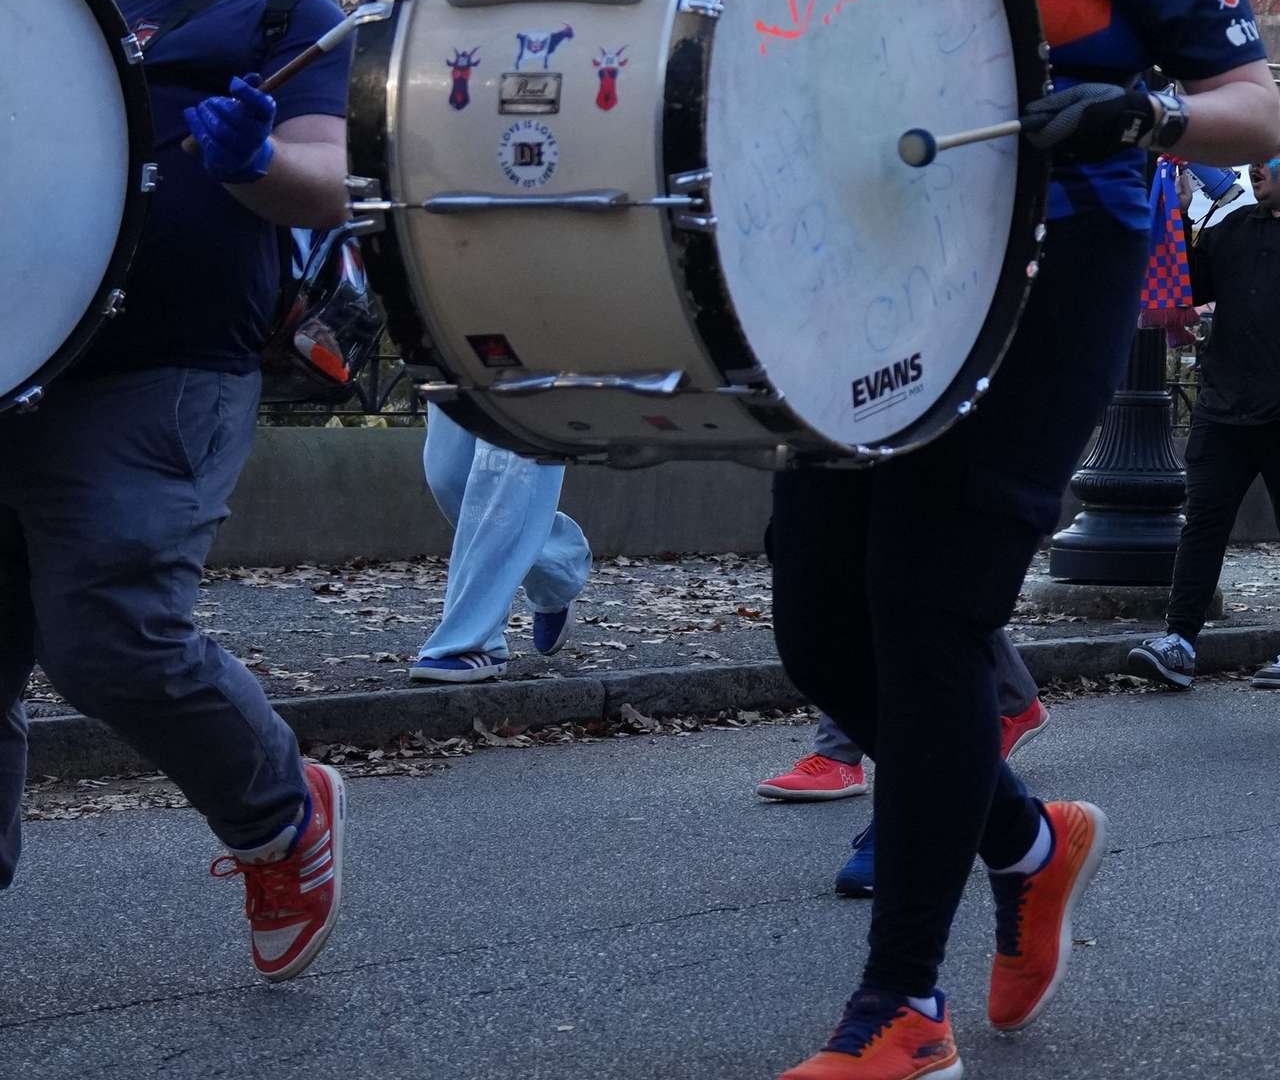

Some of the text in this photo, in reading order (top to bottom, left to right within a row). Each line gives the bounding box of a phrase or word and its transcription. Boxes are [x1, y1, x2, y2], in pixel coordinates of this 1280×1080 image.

[514, 78, 549, 98] Pearl
[500, 122, 520, 148] LOVE
[535, 122, 557, 147] LOVE
[852, 351, 924, 409] EVANS
